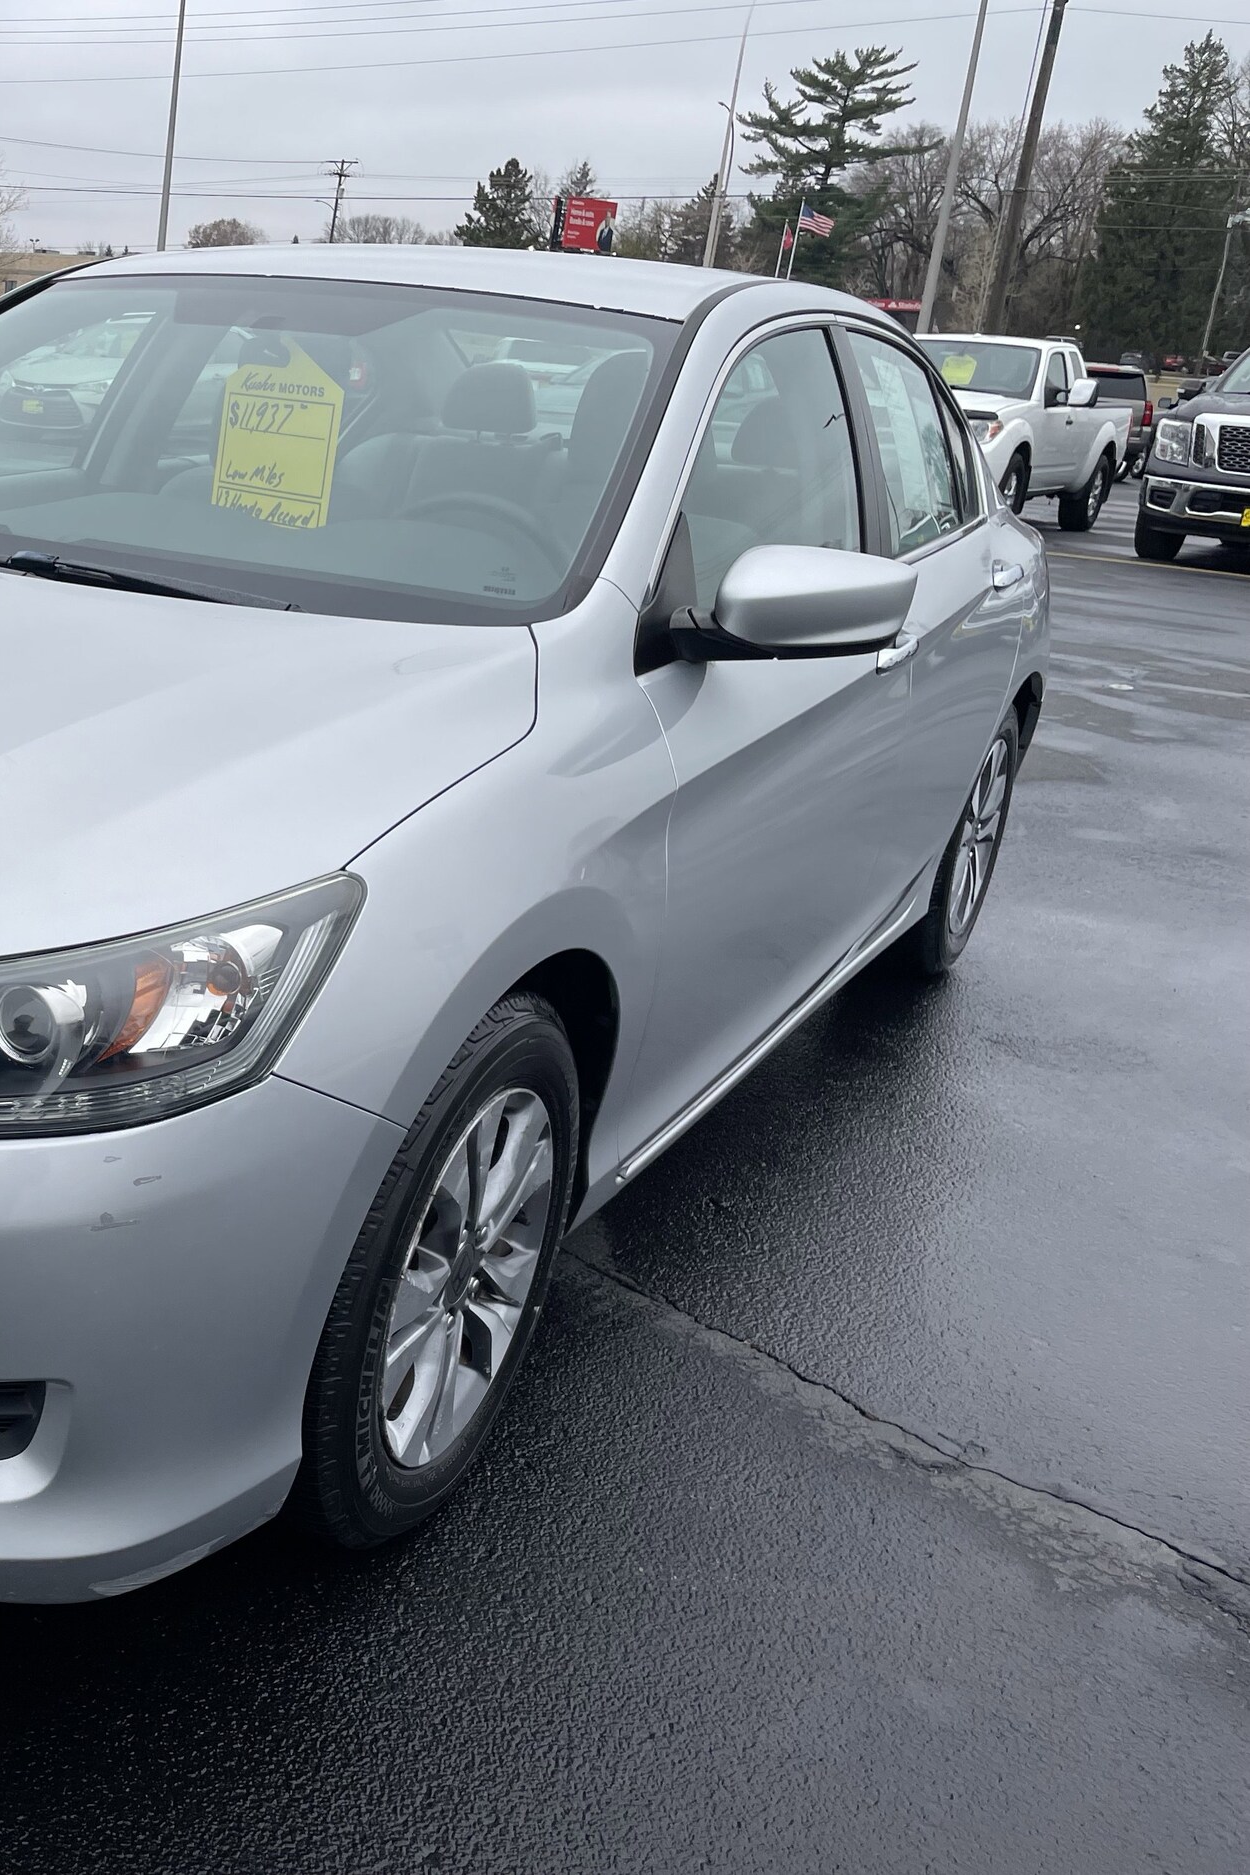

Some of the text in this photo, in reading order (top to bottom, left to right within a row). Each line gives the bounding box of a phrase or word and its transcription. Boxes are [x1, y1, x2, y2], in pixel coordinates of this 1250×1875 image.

[240, 372, 325, 398] Kuehn MOTORS
[225, 460, 285, 488] Low Miles
[263, 501, 315, 527] Accord
[356, 1285, 390, 1461] MICHELIN
